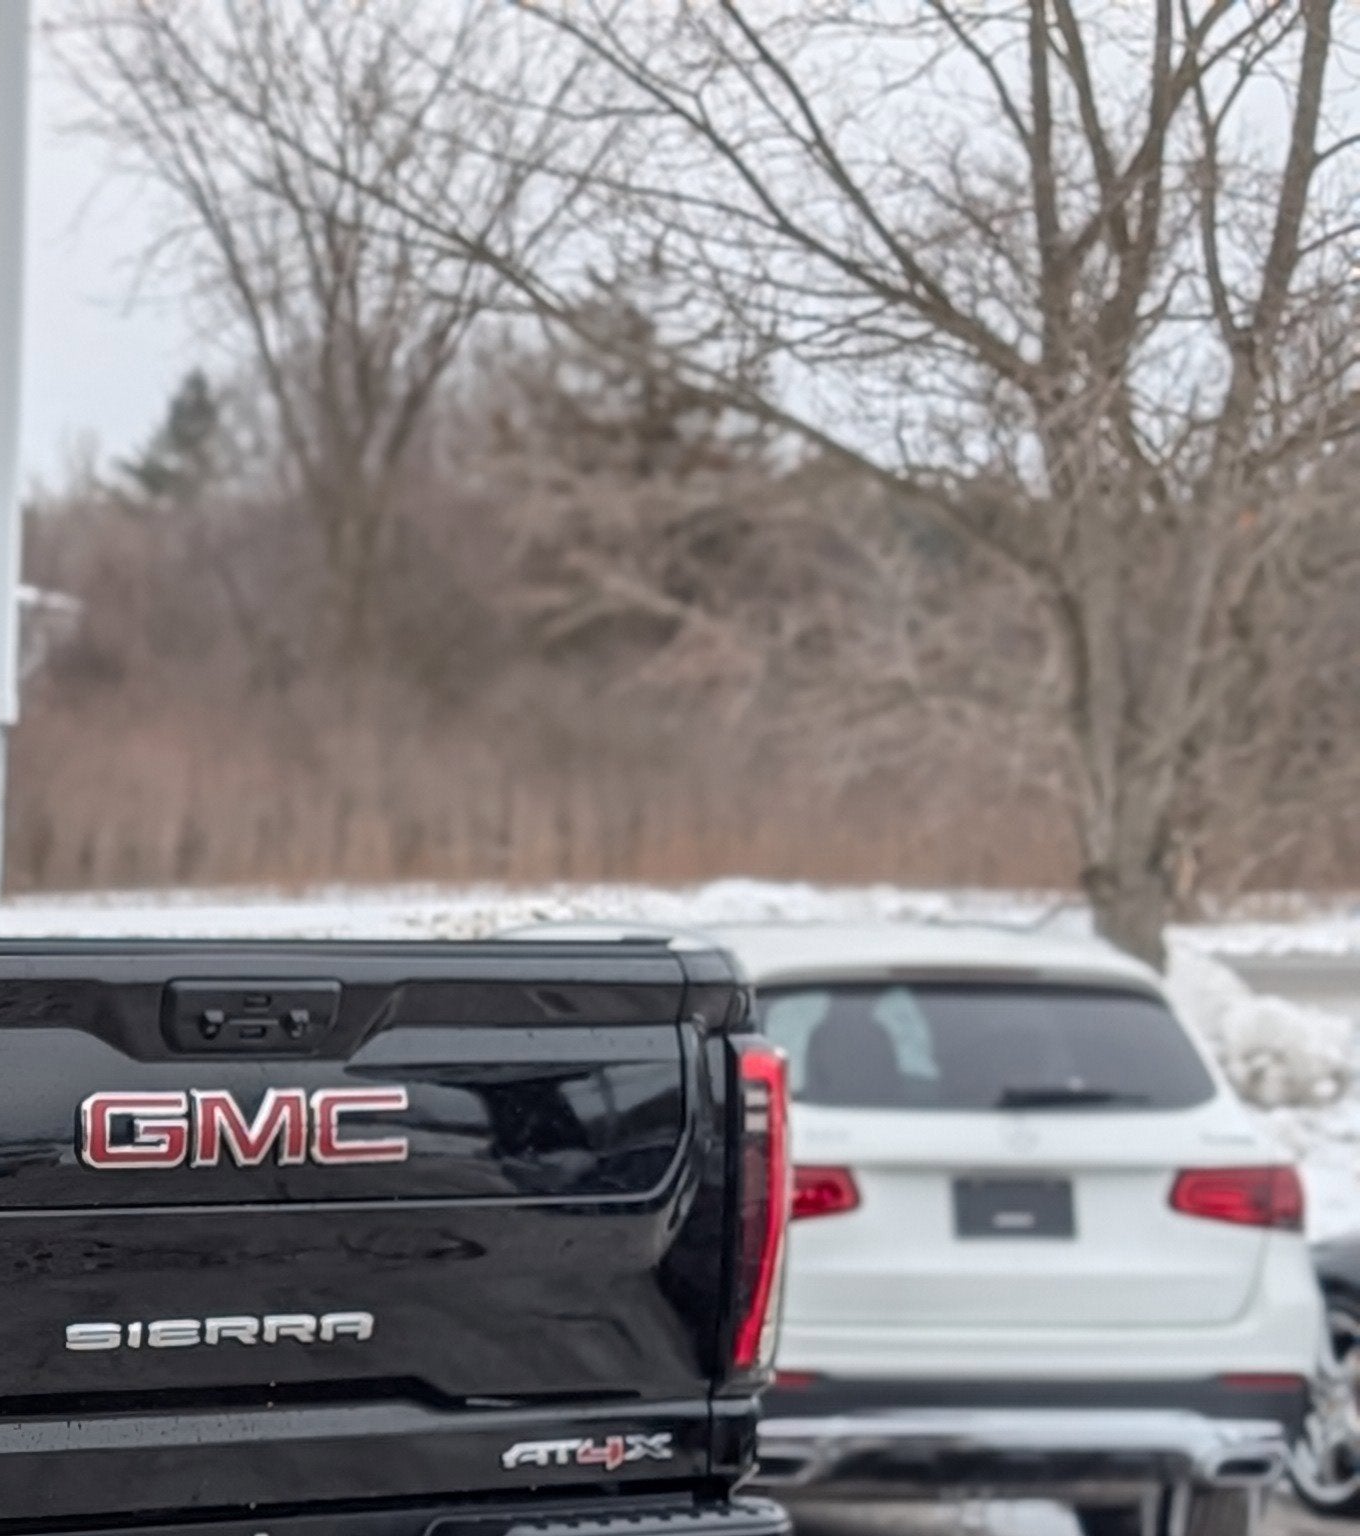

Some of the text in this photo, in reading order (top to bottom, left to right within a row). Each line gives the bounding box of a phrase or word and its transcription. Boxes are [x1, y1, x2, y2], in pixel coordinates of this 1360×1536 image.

[81, 1087, 408, 1169] GMC
[66, 1311, 374, 1350] SIERRA
[502, 1431, 673, 1471] AT4X
